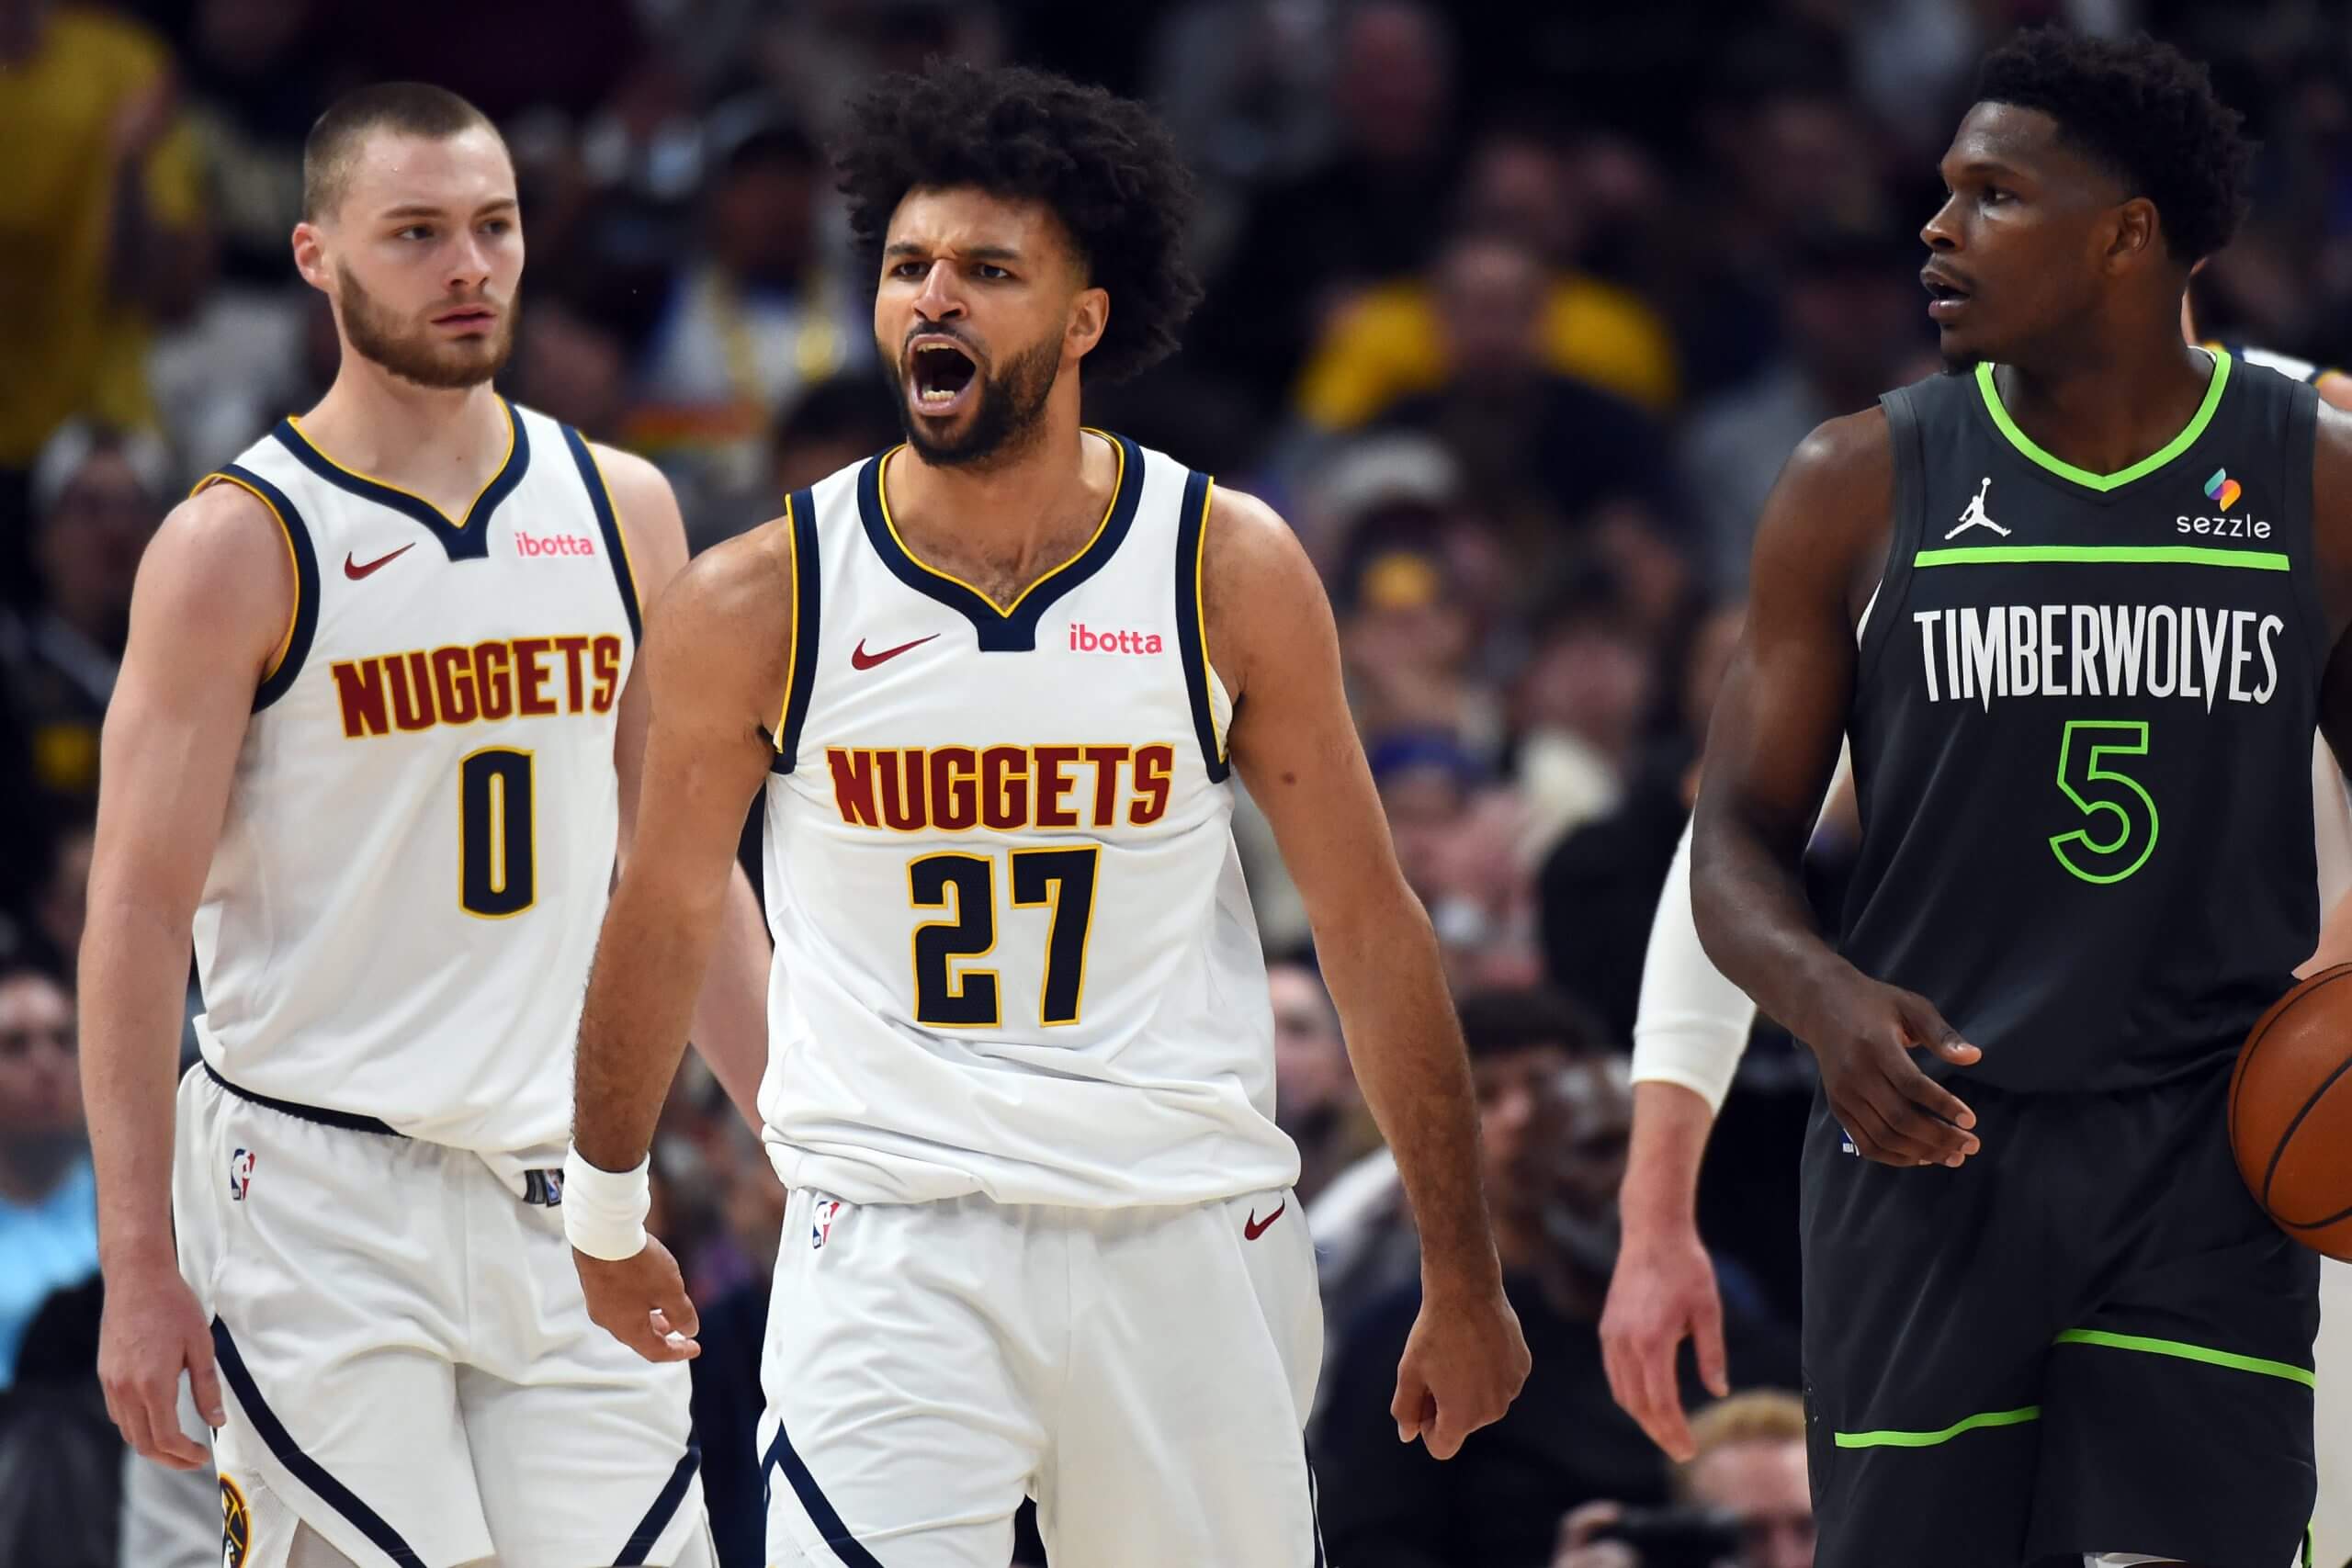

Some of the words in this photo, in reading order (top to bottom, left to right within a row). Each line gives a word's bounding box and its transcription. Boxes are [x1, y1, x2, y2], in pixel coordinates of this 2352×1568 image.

[514, 533, 594, 557] ibotta
[2176, 513, 2272, 539] sezzle
[330, 633, 622, 740] NUGGETS
[1069, 624, 1163, 655] ibotta
[1914, 604, 2285, 716] TIMBERWOLVES
[458, 745, 537, 919] 0
[825, 742, 1175, 833] NUGGETS
[2049, 720, 2159, 884] 5
[906, 843, 1102, 1029] 27
